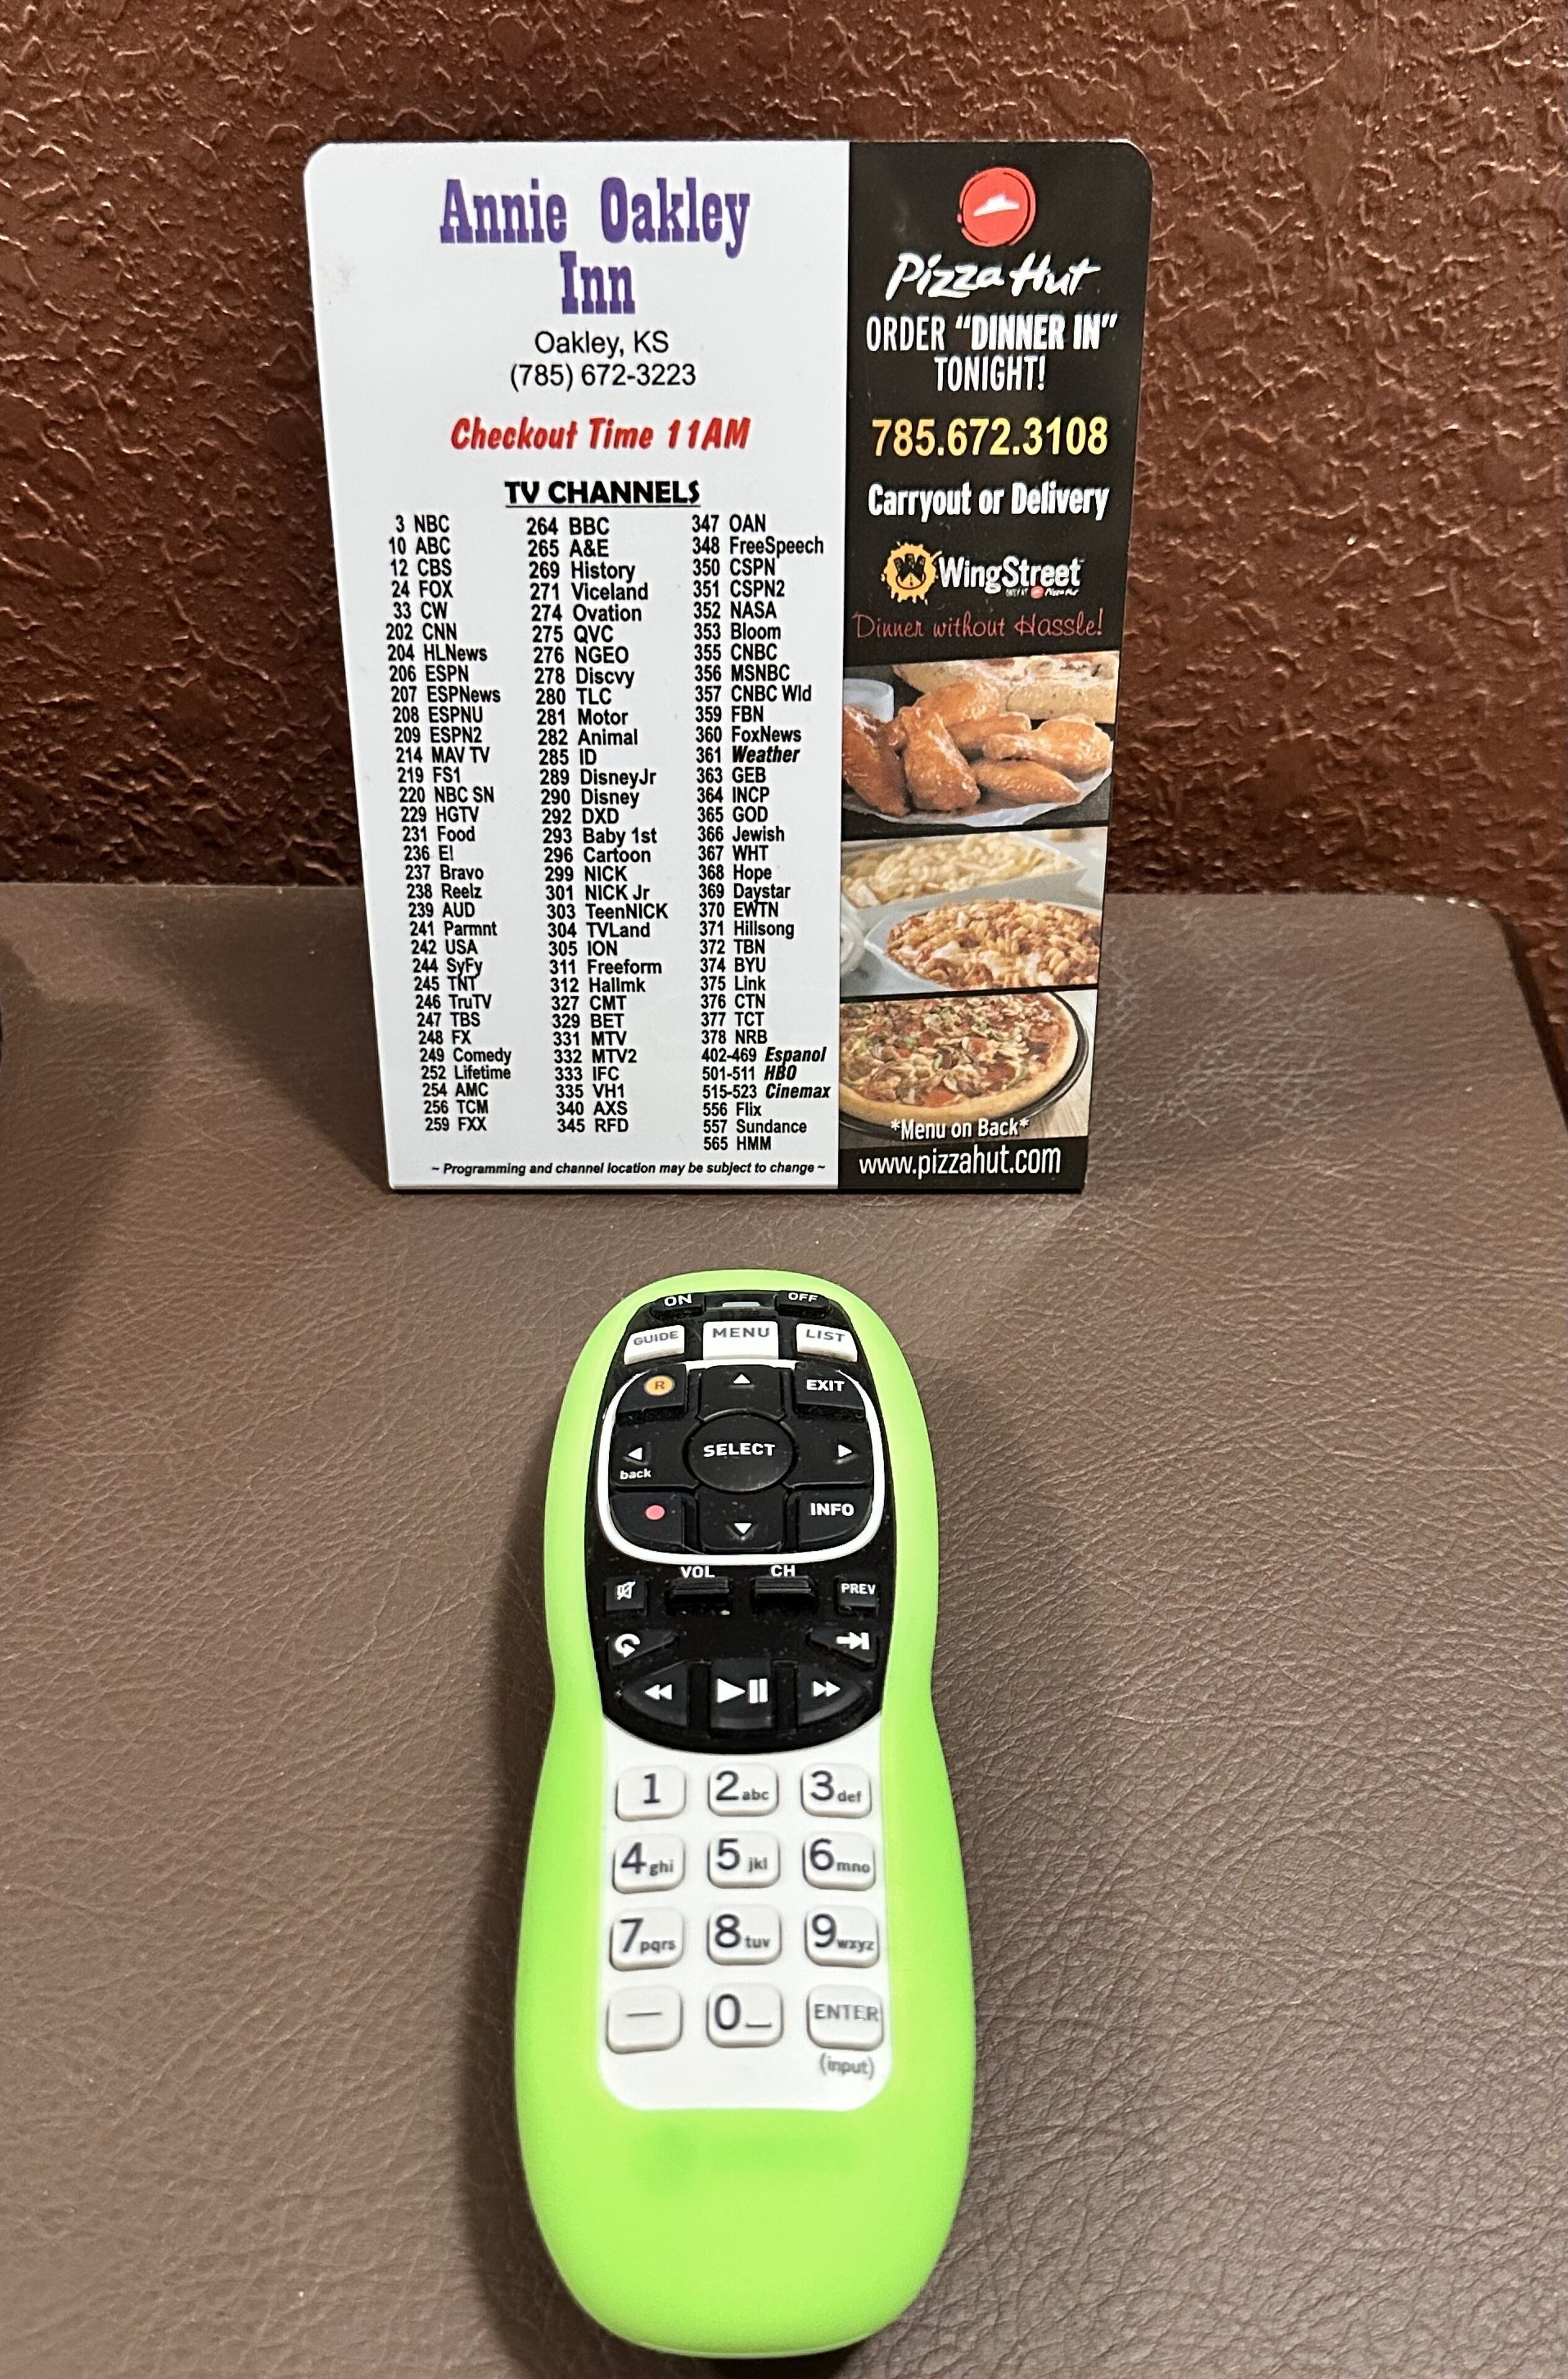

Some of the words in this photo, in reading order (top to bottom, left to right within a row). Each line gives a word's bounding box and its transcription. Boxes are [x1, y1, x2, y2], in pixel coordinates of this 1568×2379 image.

[439, 178, 567, 244] Annie
[600, 177, 750, 259] Oakley
[559, 250, 636, 315] Inn
[885, 252, 1005, 301] Pizza
[1009, 252, 1102, 297] Hut
[866, 315, 945, 352] ORDER
[535, 330, 624, 359] Oakley,
[634, 330, 669, 354] KS
[510, 363, 574, 393] (785)
[581, 363, 696, 387] 672-3223
[934, 354, 1046, 392] TONIGHT!
[450, 416, 578, 449] Checkout
[590, 416, 654, 449] Time
[872, 416, 1108, 457] 785.672.3108
[504, 481, 540, 504] TV
[548, 480, 700, 504] CHANNELS
[868, 481, 972, 523] Carryout
[978, 489, 1005, 515] or
[1011, 480, 1110, 521] Delivery
[395, 514, 405, 533] 3
[414, 514, 450, 533] NBC
[526, 517, 559, 536] 264
[569, 517, 610, 536] BBC
[692, 536, 720, 555] 348
[730, 536, 824, 559] FreeSpeech
[528, 561, 560, 579] 269
[571, 561, 636, 583] History
[938, 555, 1081, 594] WingStreet
[391, 580, 410, 598] 24
[419, 580, 453, 598] FOX
[693, 579, 719, 598] 351
[730, 579, 785, 598] CSPN2
[531, 603, 563, 622] 274
[572, 603, 642, 622] Ovation
[385, 622, 413, 641] 202
[422, 622, 457, 641] CNN
[693, 622, 721, 641] 353
[730, 622, 781, 641] Bloom
[853, 613, 922, 639] Dinner
[932, 611, 1006, 638] without
[1013, 607, 1104, 637] Hassle!
[387, 644, 415, 662] 204
[423, 644, 488, 662] HLNews
[533, 646, 564, 664] 276
[575, 646, 629, 664] NGEO
[694, 664, 722, 682] 356
[731, 664, 790, 682] MSNBC
[390, 685, 418, 703] 207
[427, 685, 501, 703] ESPNews
[694, 685, 722, 703] 357
[731, 685, 777, 703] CNBC
[782, 685, 812, 703] Wld
[537, 708, 565, 726] 281
[577, 708, 629, 726] Motor
[395, 746, 423, 763] 214
[431, 746, 465, 763] MAV
[469, 746, 490, 763] TV
[696, 746, 721, 764] 361
[732, 746, 801, 764] Weather
[540, 768, 569, 786] 289
[580, 768, 657, 789] DisneyJr
[399, 786, 426, 804] 220
[434, 786, 468, 804] NBC
[473, 786, 494, 804] SN
[402, 825, 427, 842] 231
[437, 825, 475, 842] Food
[543, 827, 572, 844] 293
[582, 827, 626, 848] Baby
[631, 827, 657, 844] 1st
[697, 825, 724, 843] 366
[732, 825, 785, 843] Jewish
[405, 864, 431, 880] 237
[440, 864, 484, 880] Bravo
[545, 884, 573, 901] 301
[585, 884, 628, 901] NICK
[633, 884, 650, 901] Jr
[698, 882, 725, 900] 369
[734, 882, 791, 903] Daystar
[546, 903, 576, 920] 303
[585, 903, 668, 920] TeenNICK
[409, 920, 434, 936] 241
[444, 920, 497, 936] Parmnt
[699, 920, 724, 937] 371
[734, 920, 794, 940] Hillsong
[550, 958, 576, 975] 311
[587, 958, 662, 975] Freeform
[415, 994, 441, 1009] 246
[449, 994, 492, 1009] TruTV
[552, 1013, 580, 1029] 329
[590, 1013, 624, 1029] BET
[701, 1047, 757, 1062] 402-469
[764, 1047, 826, 1066] Espanol
[421, 1065, 447, 1080] 252
[454, 1065, 511, 1080] Lifetime
[555, 1084, 584, 1099] 335
[592, 1084, 624, 1099] VH1
[702, 1084, 757, 1099] 515-523
[765, 1084, 831, 1099] Cinemax
[425, 1116, 450, 1132] 259
[458, 1116, 487, 1132] FXX
[703, 1119, 728, 1134] 557
[736, 1119, 807, 1134] Sundance
[950, 1120, 973, 1139] on
[443, 1162, 527, 1177] Programming
[529, 1162, 553, 1174] and
[555, 1162, 605, 1174] channel
[607, 1162, 656, 1174] location
[659, 1164, 686, 1176] may
[688, 1162, 704, 1173] be
[706, 1162, 752, 1176] subject
[755, 1162, 767, 1173] to
[769, 1161, 815, 1176] change
[859, 1144, 1061, 1180] www.pizzahut.com
[664, 1294, 693, 1307] ON
[787, 1291, 818, 1302] OFF
[633, 1330, 680, 1347] GUIDE
[712, 1327, 769, 1338] MENU
[805, 1329, 846, 1343] LIST
[654, 1380, 665, 1390] R
[806, 1379, 845, 1392] EXIT
[703, 1442, 776, 1458] SELECT
[620, 1468, 652, 1480] back
[810, 1502, 854, 1517] INFO
[680, 1565, 716, 1579] VOL
[770, 1564, 796, 1578] CH
[841, 1583, 876, 1595] PREV
[814, 2003, 879, 2022] ENTER
[819, 2051, 875, 2080] (input)
